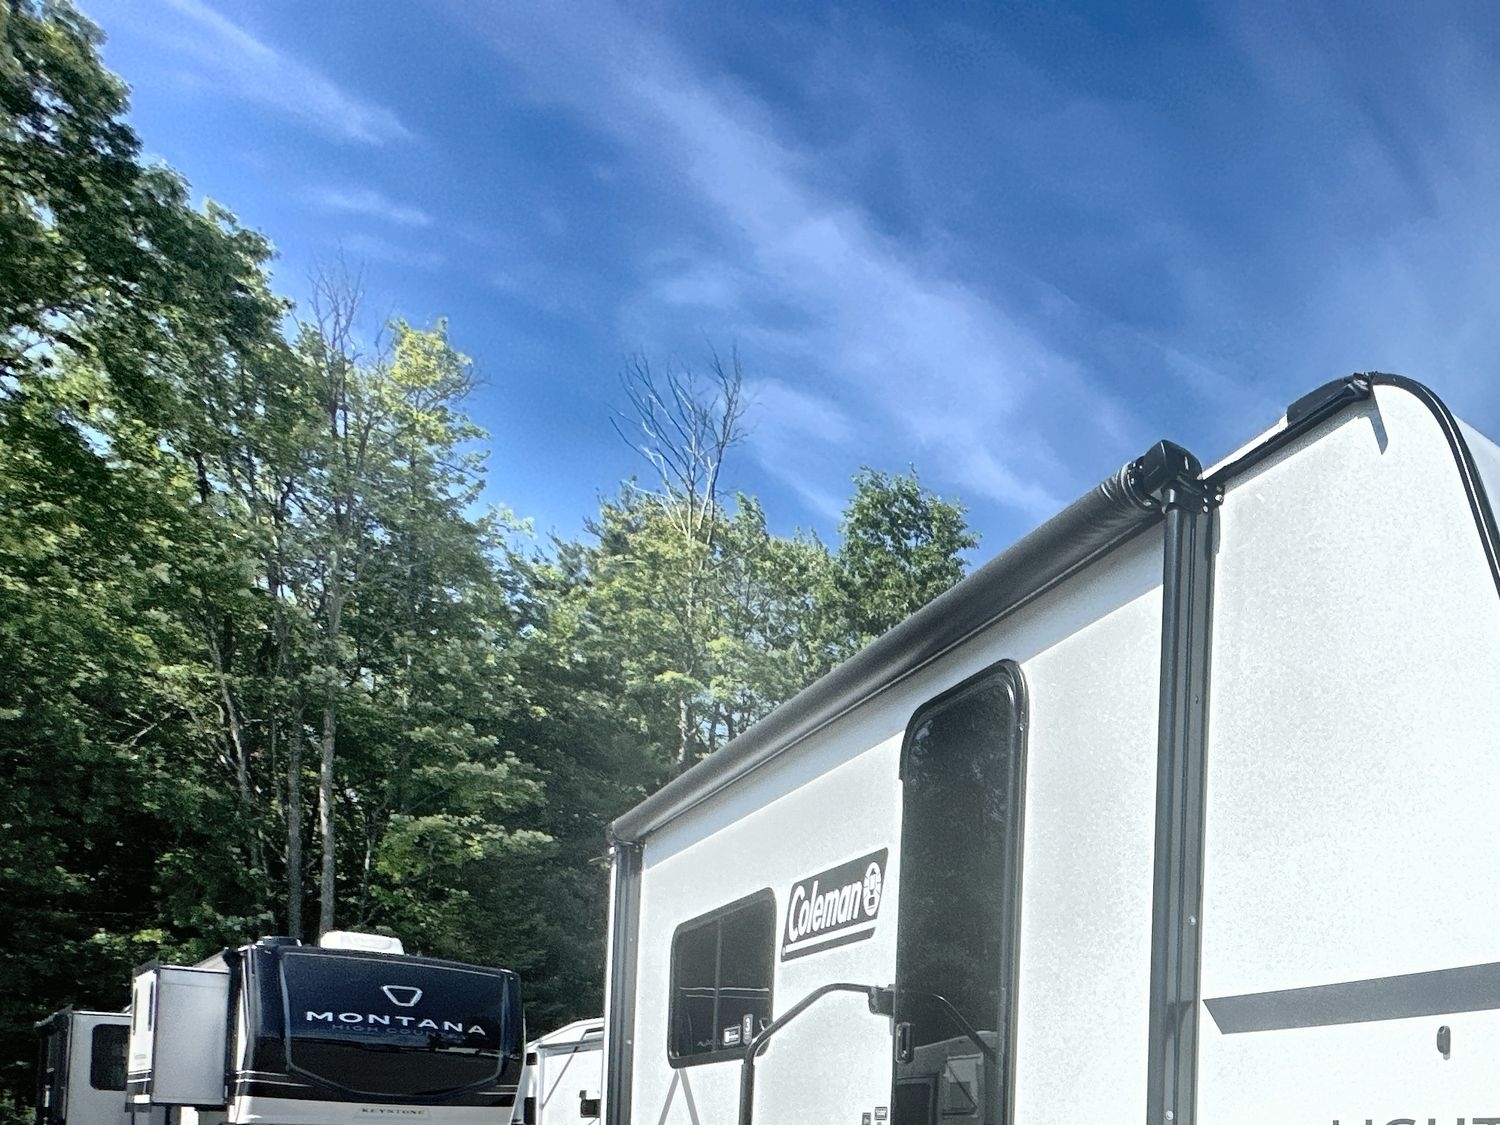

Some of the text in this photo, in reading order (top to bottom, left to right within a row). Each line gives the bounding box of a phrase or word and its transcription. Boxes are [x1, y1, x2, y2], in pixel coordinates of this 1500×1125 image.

[788, 880, 863, 942] Coleman
[306, 1011, 487, 1036] MONTANA
[332, 1024, 379, 1033] HIGH
